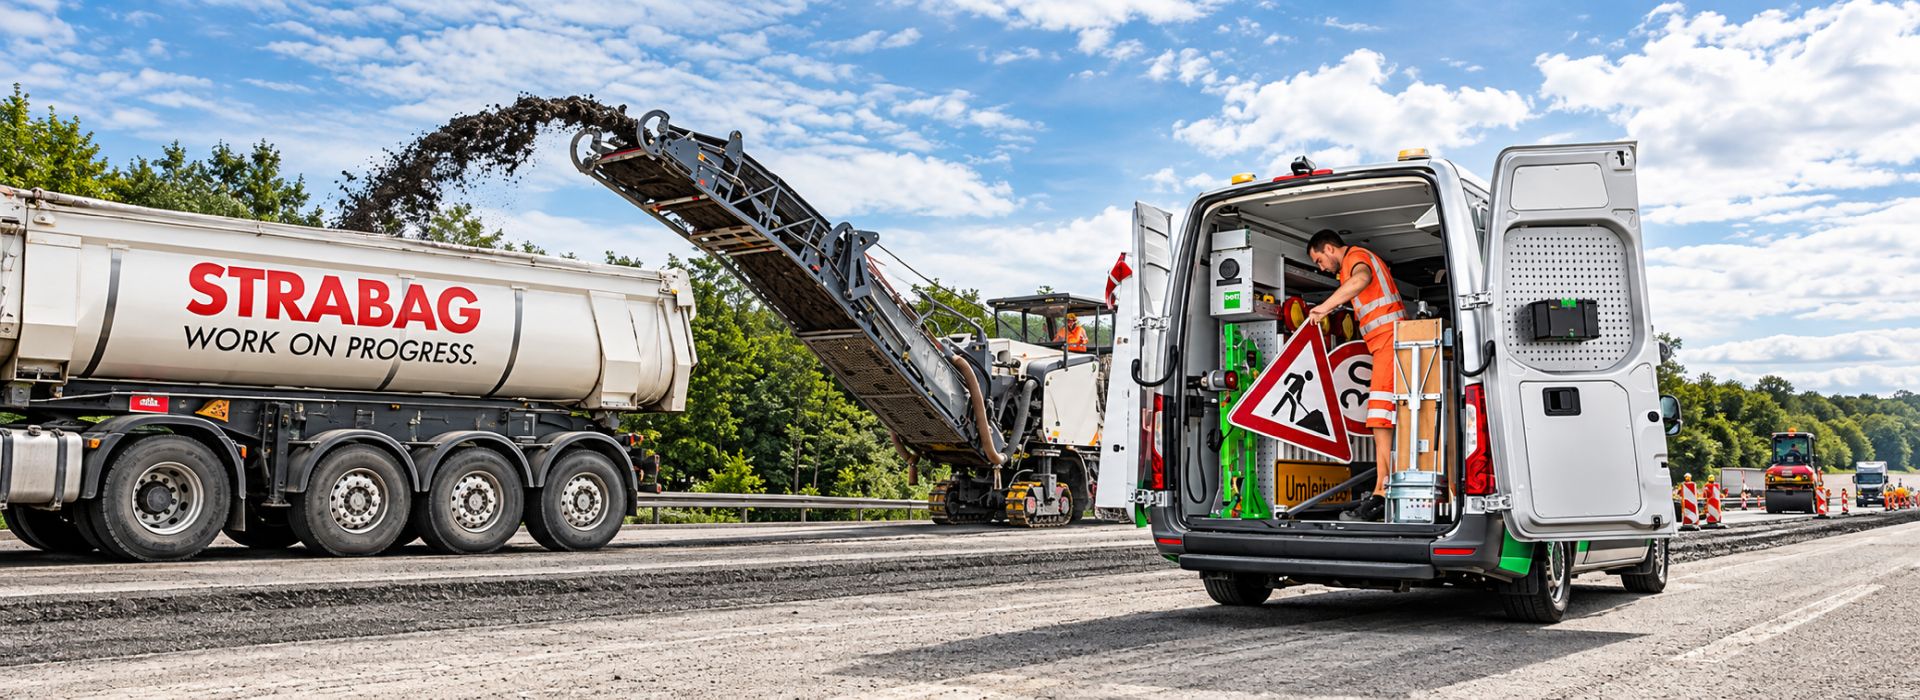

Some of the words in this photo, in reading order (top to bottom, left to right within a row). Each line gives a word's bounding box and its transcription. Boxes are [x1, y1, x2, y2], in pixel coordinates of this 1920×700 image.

[186, 262, 481, 334] STRABAG
[184, 325, 280, 354] WORK
[289, 333, 337, 357] ON
[346, 336, 477, 365] PROGRESS.
[1340, 361, 1373, 409] 30
